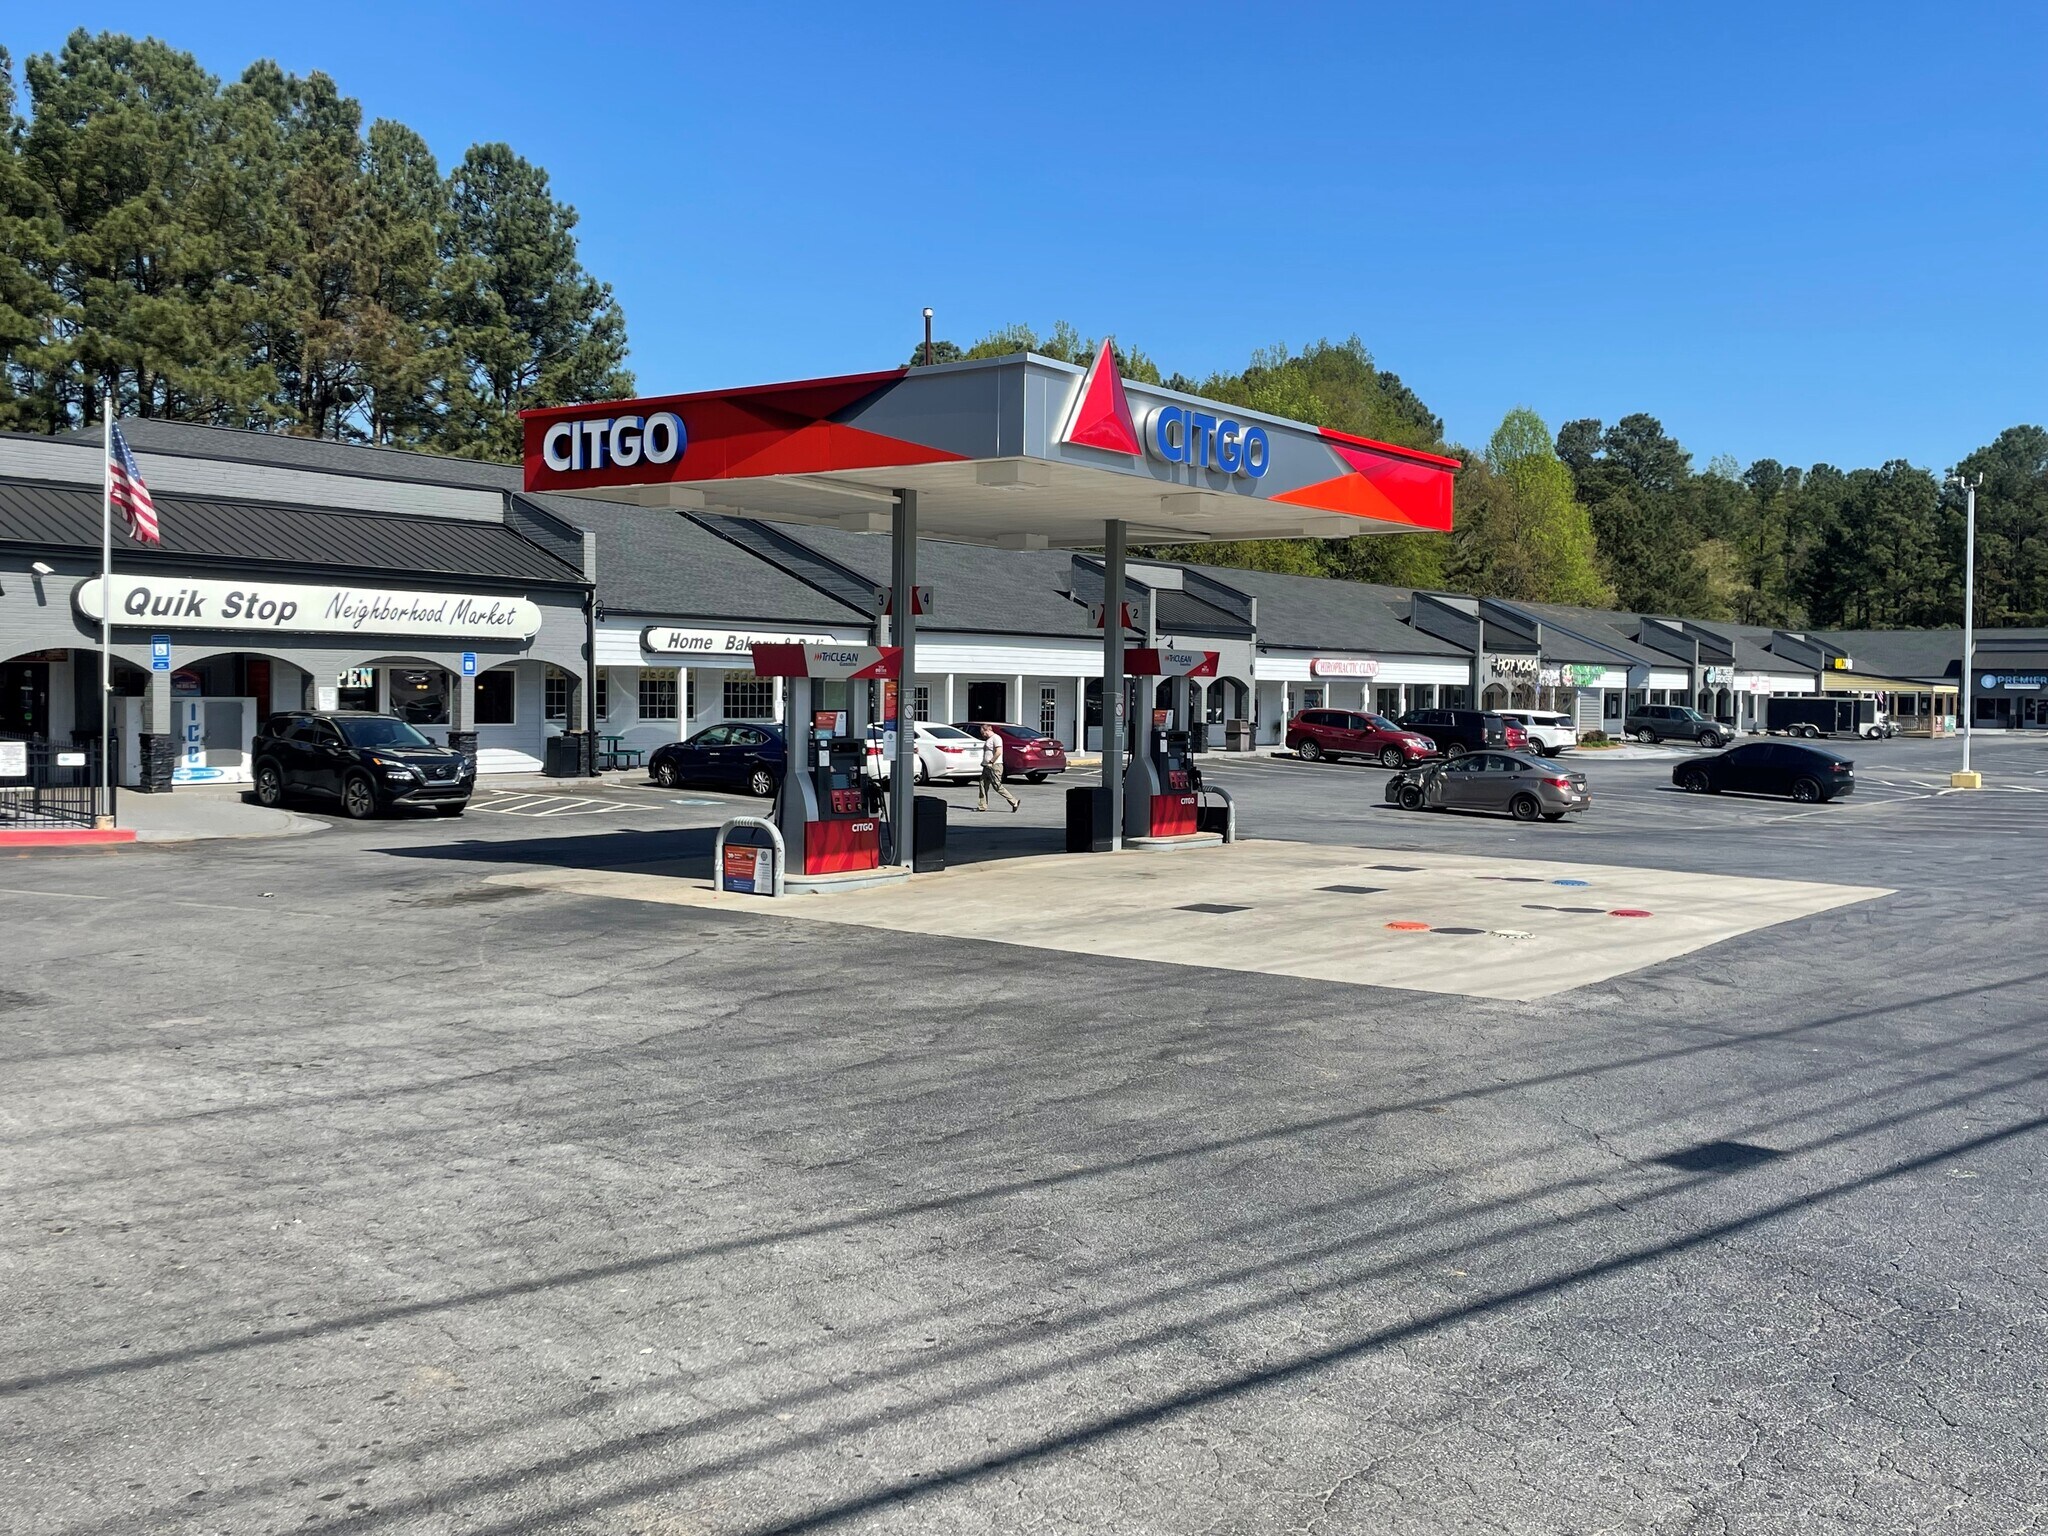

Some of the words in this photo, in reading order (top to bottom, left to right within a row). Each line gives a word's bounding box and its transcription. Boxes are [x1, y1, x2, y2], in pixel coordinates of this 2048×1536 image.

[543, 411, 687, 472] CITGO
[1147, 405, 1270, 479] CITGO
[878, 594, 884, 606] 3
[923, 593, 929, 605] 4
[124, 586, 207, 617] Quik
[221, 590, 298, 626] Stop
[325, 591, 448, 629] Neighborhood
[449, 598, 517, 626] Market
[1091, 609, 1096, 620] 1
[1132, 608, 1139, 619] 2
[667, 632, 713, 650] Home
[822, 652, 859, 662] TriCLEAN
[1317, 661, 1359, 674] CHIROPRACTIC
[1497, 658, 1516, 671] HOT
[1997, 675, 2048, 684] PREMIER
[1181, 797, 1195, 805] CITGO
[852, 823, 874, 832] CITGO
